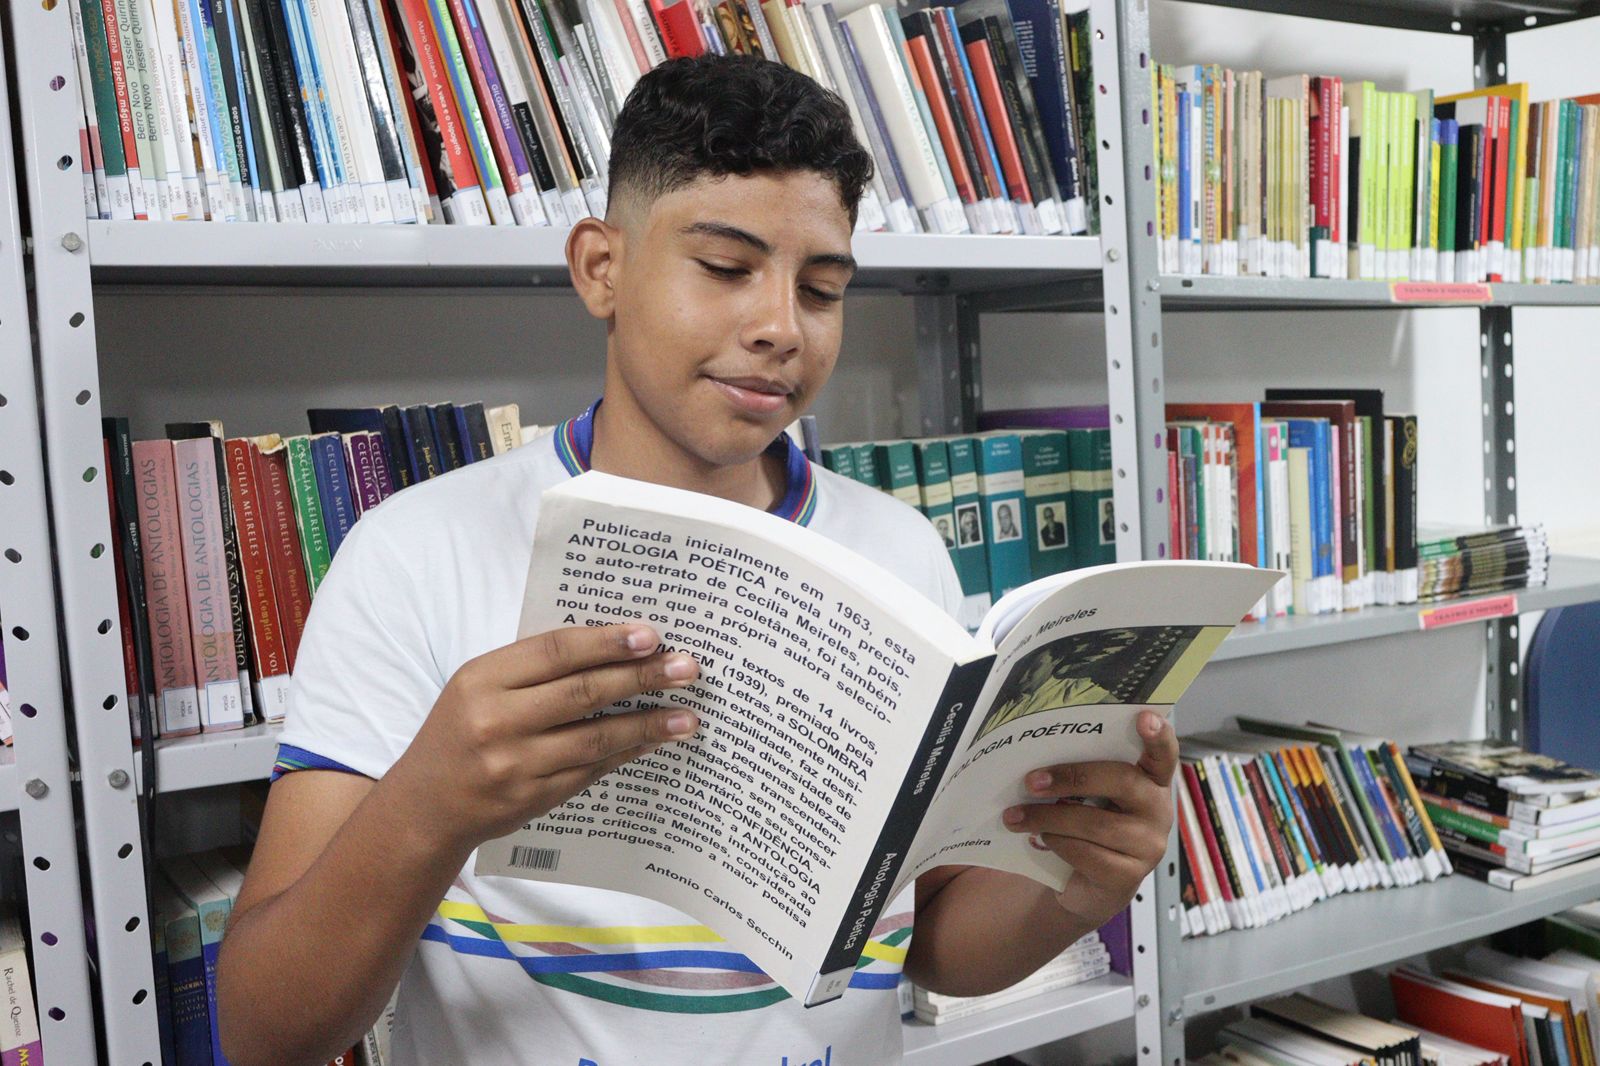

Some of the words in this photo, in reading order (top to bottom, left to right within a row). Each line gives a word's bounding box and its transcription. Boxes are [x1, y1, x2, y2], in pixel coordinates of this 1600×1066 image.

[107, 14, 119, 53] Quintana
[182, 13, 191, 40] mesmo
[124, 36, 135, 70] Jessier
[136, 38, 148, 72] Jessier
[150, 48, 159, 73] POEMAS
[184, 43, 196, 70] espaço
[113, 60, 126, 97] Espelho
[132, 82, 142, 108] Novo
[143, 84, 153, 110] Novo
[194, 87, 204, 116] arnaldo
[424, 44, 439, 78] Quintana
[438, 92, 448, 108] vaca
[446, 122, 463, 156] hipogrifo
[118, 99, 130, 133] mágico
[136, 112, 146, 140] Berro
[148, 114, 158, 142] Berro
[234, 125, 240, 135] do
[492, 84, 511, 130] GILGAMESH
[236, 136, 248, 181] rugosidades
[358, 442, 373, 490] CECÍLIA
[372, 442, 386, 488] CECÍLIA
[423, 447, 431, 464] João
[141, 459, 164, 564] ANTOLOGIAS
[186, 462, 208, 566] ANTOLOGIAS
[326, 444, 340, 492] CECÍLIA
[336, 496, 347, 537] MEIRE
[234, 447, 248, 496] CECÍLIA
[244, 500, 259, 556] MEIRELES
[254, 568, 264, 598] Poesia
[307, 497, 322, 552] MEIRELES
[224, 550, 238, 593] CASA
[276, 500, 292, 556] MEIRELES
[288, 568, 298, 598] Poesia
[152, 568, 167, 591] DE
[196, 570, 210, 592] DE
[583, 519, 671, 543] Publicada
[686, 536, 788, 580] inicialmente
[801, 583, 823, 600] em
[838, 602, 872, 635] 1963,
[885, 638, 915, 664] esta
[557, 599, 588, 610] nou
[595, 603, 642, 618] todos
[649, 614, 668, 623] os
[674, 619, 741, 648] poemas.
[566, 552, 586, 562] so
[596, 558, 697, 580] auto-retrato
[707, 577, 726, 589] de
[736, 586, 788, 618] Cecília
[796, 615, 859, 665] Meireles,
[868, 666, 900, 696] pois,
[568, 534, 678, 560] ANTOLOGIA
[689, 554, 765, 588] POÉTICA
[775, 587, 820, 618] revela
[829, 619, 851, 638] um
[858, 640, 908, 678] precio-
[1036, 607, 1098, 636] Meireles
[156, 596, 176, 689] ANTOLOGIA
[563, 568, 615, 582] sendo
[622, 577, 652, 588] sua
[659, 583, 728, 607] primeira
[734, 605, 810, 651] coletânea,
[818, 648, 836, 666] foi
[841, 664, 896, 710] também
[578, 584, 623, 600] única
[632, 596, 657, 605] em
[666, 601, 696, 613] que
[705, 611, 713, 619] a
[721, 617, 776, 648] própria
[784, 648, 830, 680] autora
[837, 681, 890, 723] selecio-
[564, 614, 575, 624] A
[665, 632, 734, 660] escolheu
[743, 658, 784, 687] textos
[793, 689, 809, 702] de
[819, 704, 832, 718] 14
[840, 718, 877, 754] livros,
[706, 676, 723, 688] de
[728, 683, 772, 716] Letras,
[777, 714, 785, 722] a
[788, 718, 866, 781] SOLOMBRA
[723, 665, 767, 696] (1939),
[776, 696, 839, 740] premiado
[846, 743, 873, 767] pela
[936, 702, 963, 745] Cecília
[1018, 722, 1104, 742] POÉTICA
[670, 694, 793, 762] comunicabilidade,
[800, 760, 818, 778] faz
[823, 778, 856, 806] desfi-
[730, 704, 824, 765] extremamente
[827, 764, 862, 792] musi-
[913, 746, 944, 795] Meireles
[677, 740, 754, 783] indagações
[761, 782, 840, 844] transcenden-
[711, 739, 726, 752] às
[732, 752, 794, 794] pequenas
[800, 792, 845, 832] belezas
[714, 727, 755, 753] ampla
[760, 752, 832, 805] diversidade
[836, 806, 851, 820] de
[610, 767, 681, 789] ANCEIRO
[685, 784, 704, 800] DA
[709, 796, 812, 872] INCONFIDÊNCIA.
[685, 770, 743, 806] libertário
[746, 806, 761, 818] de
[765, 818, 787, 836] seu
[791, 836, 830, 869] consa-
[687, 756, 743, 794] humano,
[750, 792, 776, 813] sem
[780, 813, 836, 856] esquecer
[537, 823, 582, 834] língua
[588, 830, 674, 853] portuguesa.
[591, 804, 609, 812] de
[616, 806, 665, 824] Cecília
[672, 820, 730, 857] Meireles,
[736, 857, 810, 916] considerada
[600, 791, 608, 799] é
[616, 795, 648, 806] uma
[656, 804, 722, 836] excelente
[728, 835, 795, 888] introdução
[801, 891, 816, 904] ao
[616, 782, 659, 796] esses
[666, 793, 724, 826] motivos,
[730, 824, 738, 832] a
[742, 832, 819, 894] ANTOLOGIA
[939, 839, 992, 854] Fronteira
[549, 812, 594, 823] vários
[602, 819, 656, 834] críticos
[664, 833, 702, 852] como
[722, 861, 758, 888] maior
[762, 890, 806, 928] poetisa
[863, 852, 898, 908] Antologia
[645, 864, 699, 890] Antonio
[704, 889, 742, 919] Carlos
[747, 918, 792, 960] Secchin
[844, 909, 872, 950] Poética
[4, 968, 16, 995] Rachel
[10, 996, 16, 1006] de
